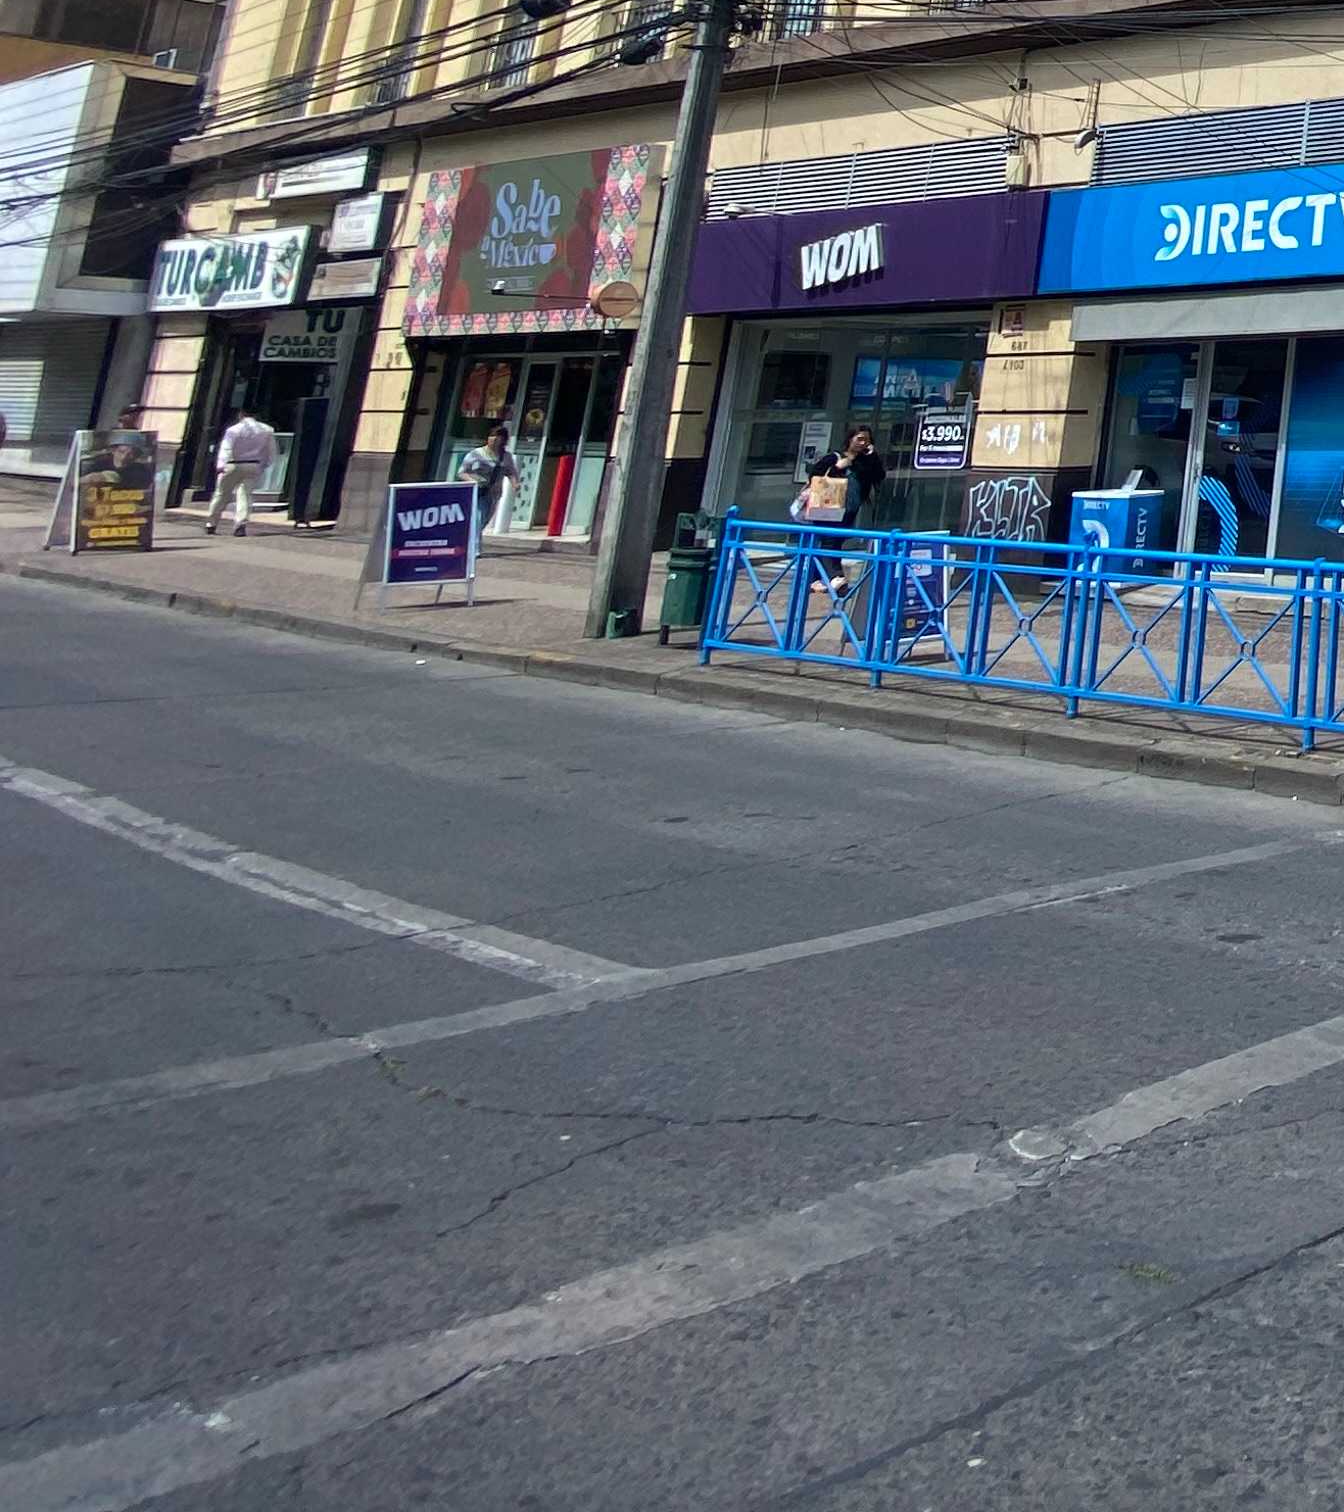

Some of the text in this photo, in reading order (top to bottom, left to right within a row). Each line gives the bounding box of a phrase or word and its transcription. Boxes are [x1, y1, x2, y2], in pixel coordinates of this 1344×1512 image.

[491, 178, 561, 238] Sabe
[801, 223, 884, 290] WOM
[306, 310, 346, 332] TU
[263, 347, 336, 359] CAMBIOS
[268, 336, 337, 347] CASA DE
[397, 502, 465, 531] WOM
